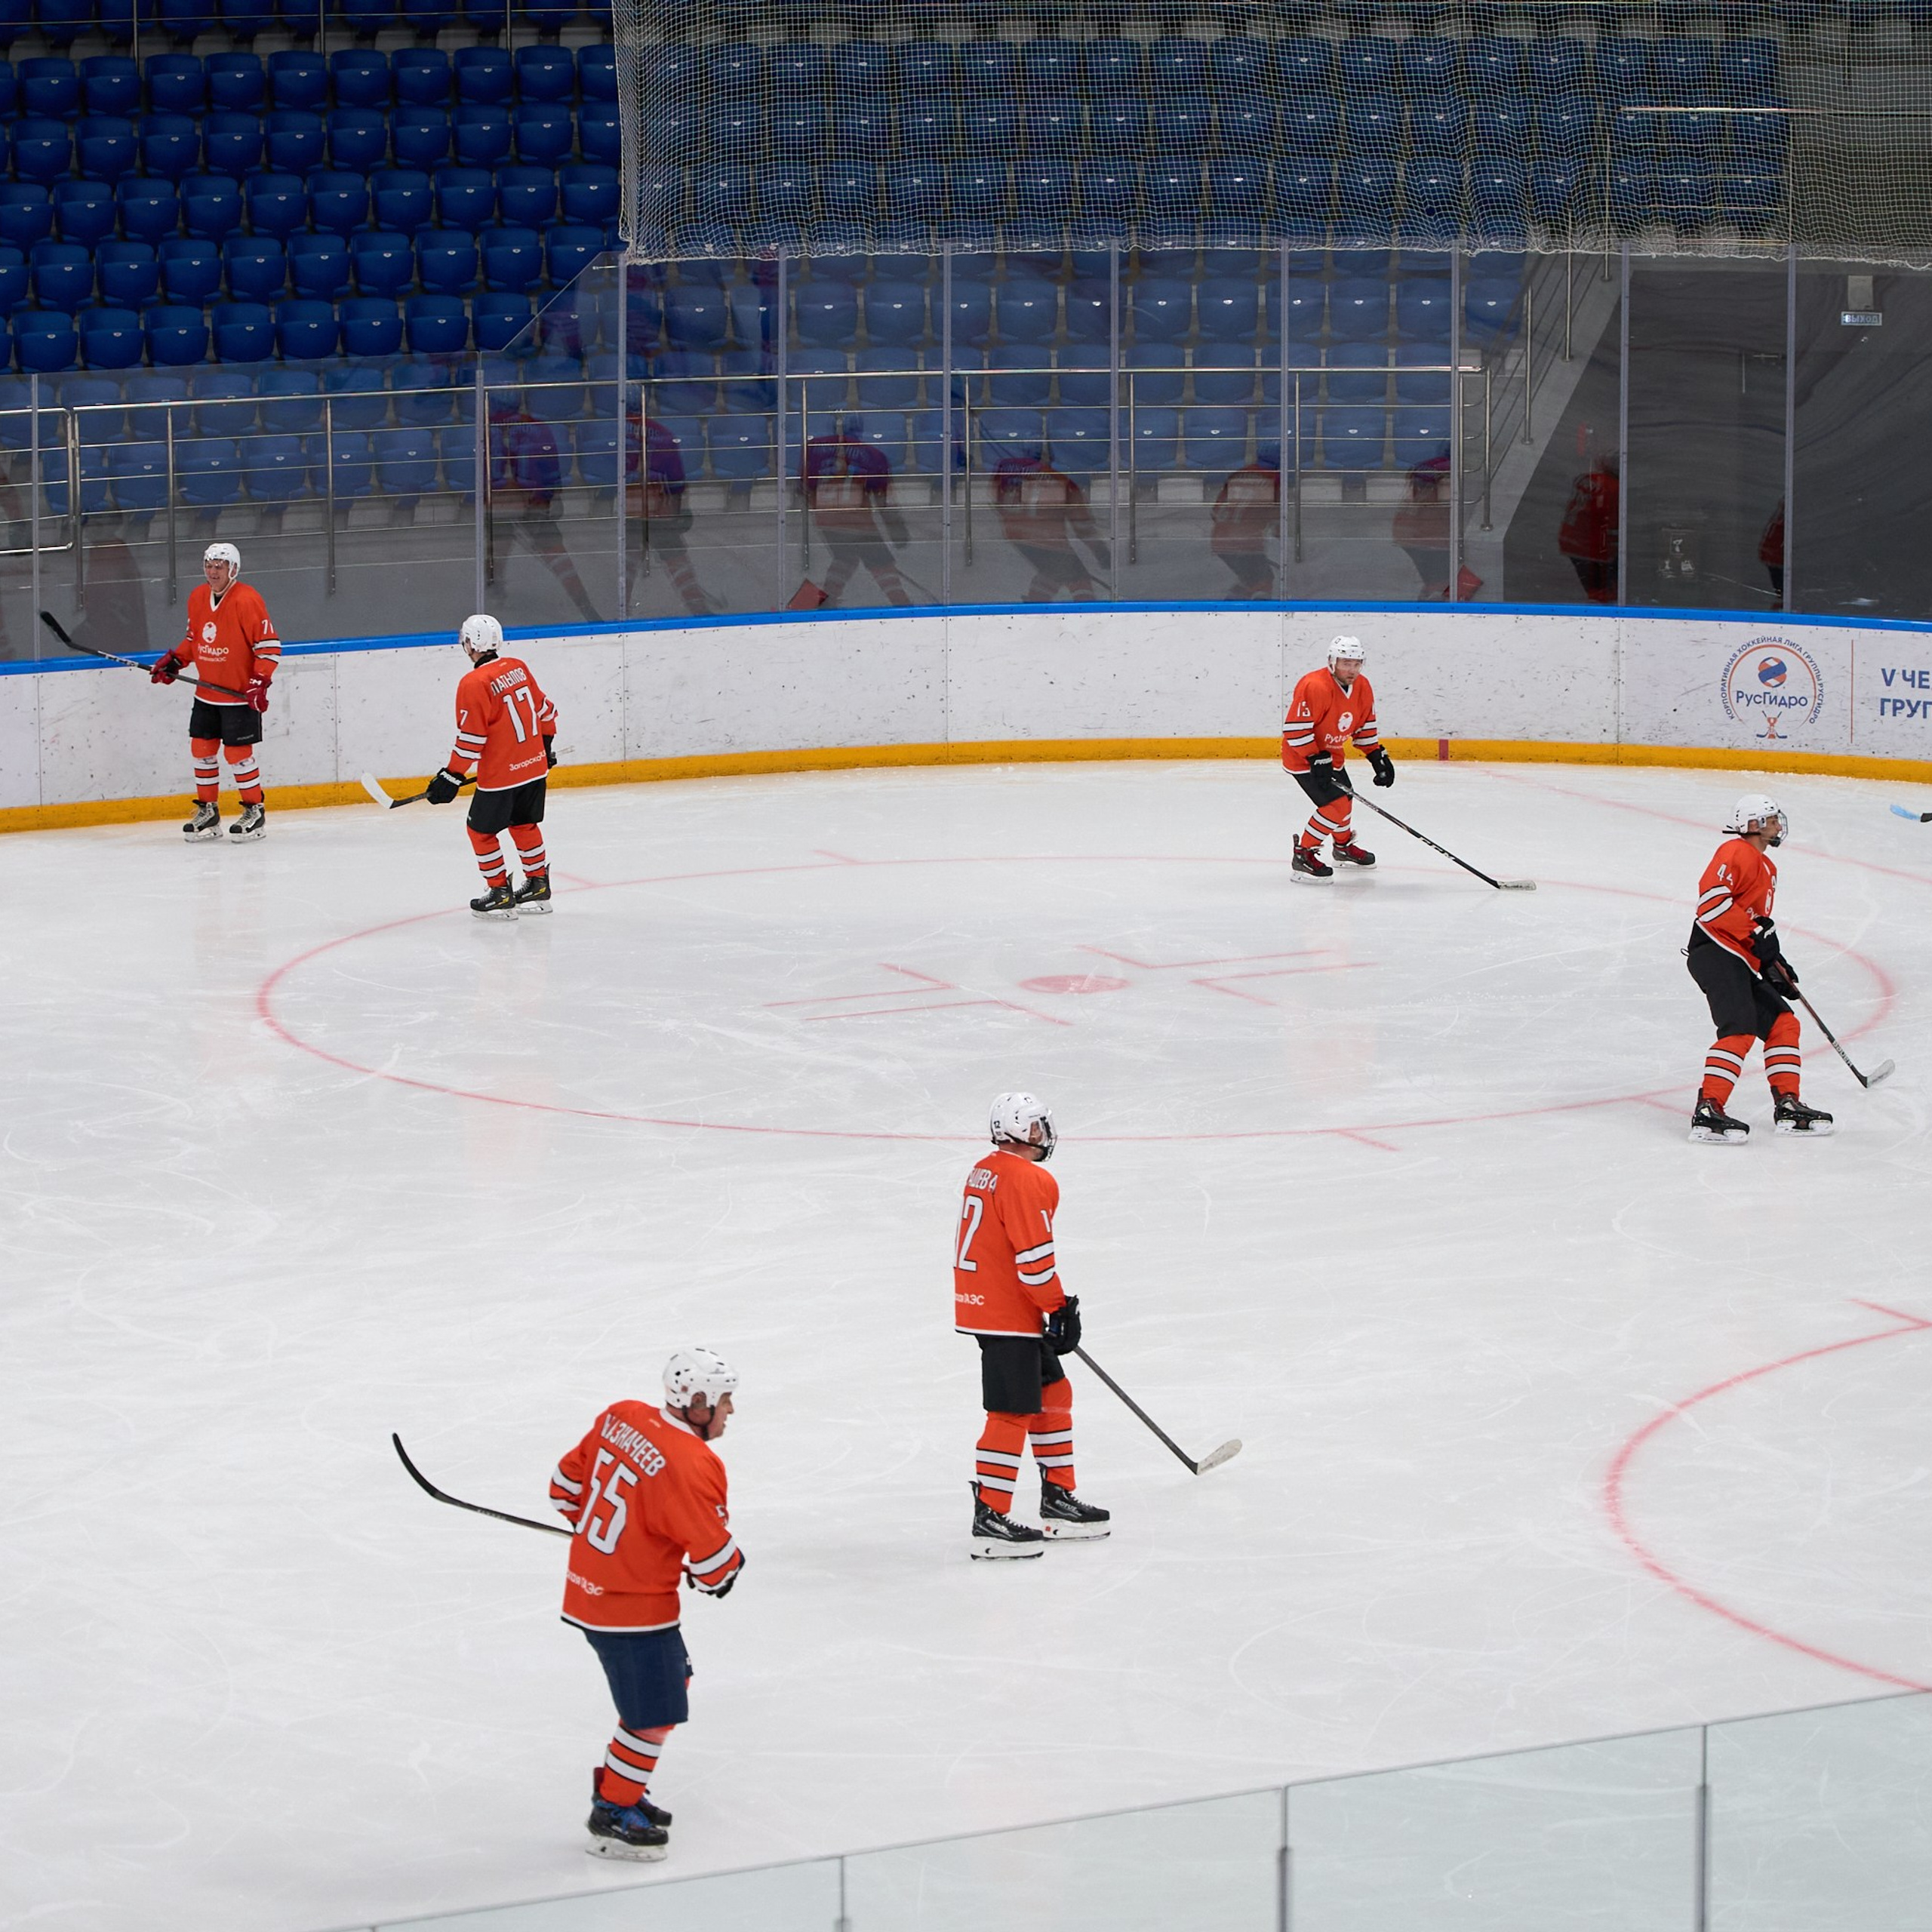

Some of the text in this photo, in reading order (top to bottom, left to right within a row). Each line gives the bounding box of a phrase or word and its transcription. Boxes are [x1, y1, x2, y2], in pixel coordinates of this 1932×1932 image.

[1845, 314, 1878, 323] ВЫХОД
[1721, 635, 1824, 724] КОРПОРАТИВНАЯ ХОККЕЙНАЯ ЛИГА ГРУППЫ РУСГИДРО
[1881, 668, 1897, 687] V
[502, 685, 539, 743] 17
[1736, 691, 1808, 709] РусГидро
[574, 1446, 641, 1556] 55
